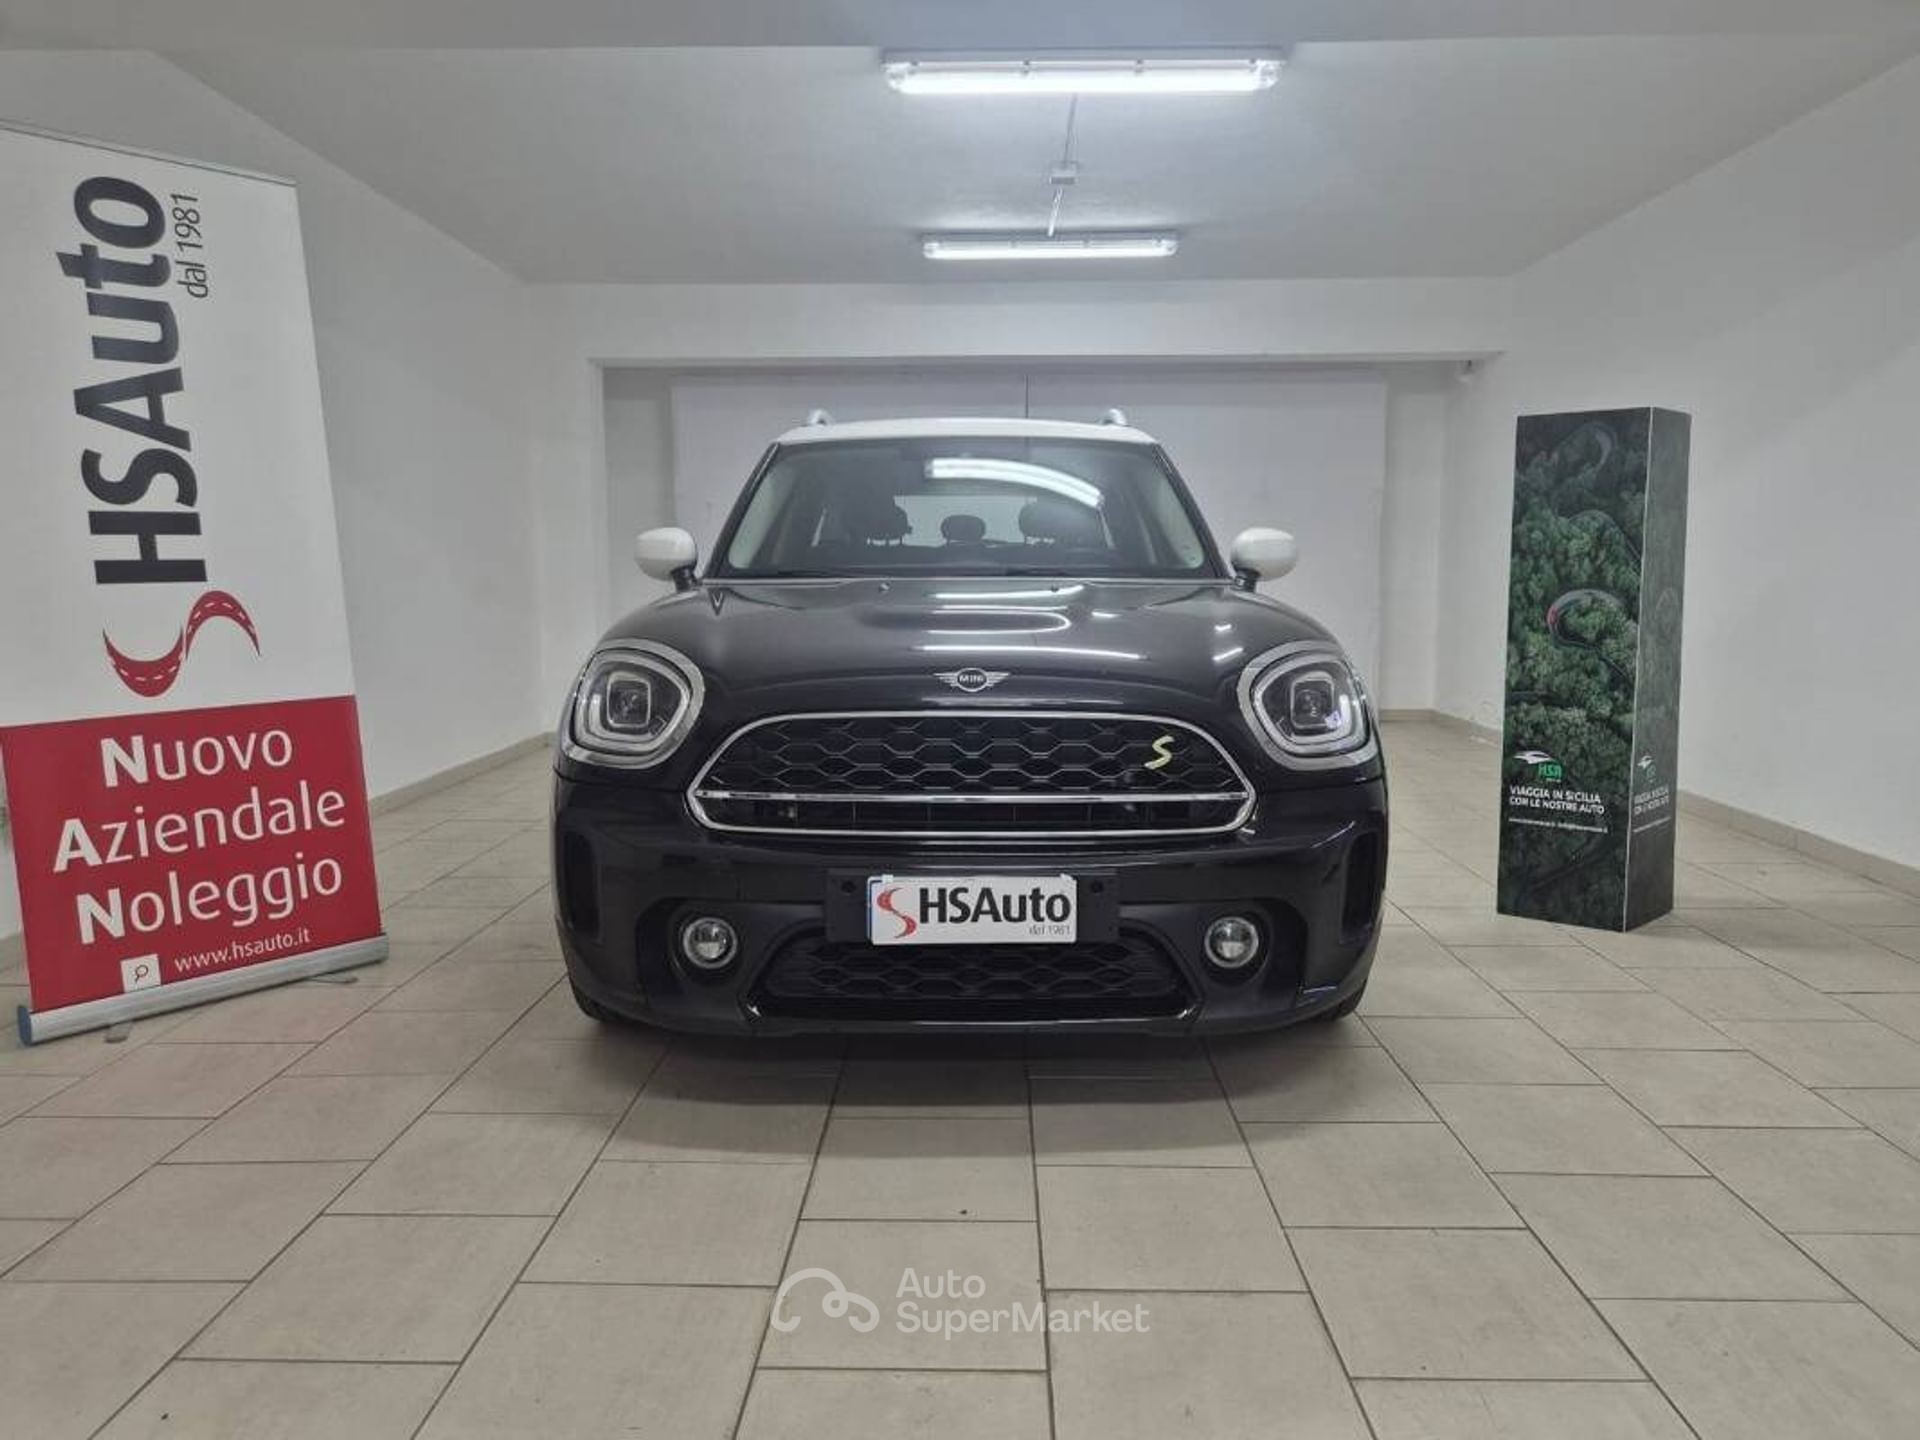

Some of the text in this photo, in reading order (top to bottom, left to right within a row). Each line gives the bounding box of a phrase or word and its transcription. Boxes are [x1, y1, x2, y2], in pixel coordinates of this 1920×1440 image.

[170, 193, 208, 299] dal 1981
[56, 176, 208, 584] HSAuto
[53, 780, 346, 873] Aziendale
[1510, 785, 1601, 803] VIAGGIA IN SICILIA
[1579, 804, 1605, 815] AUTO
[75, 852, 343, 944] Noleggio
[919, 887, 1072, 923] HSAuto
[174, 928, 311, 973] www.hsauto.it
